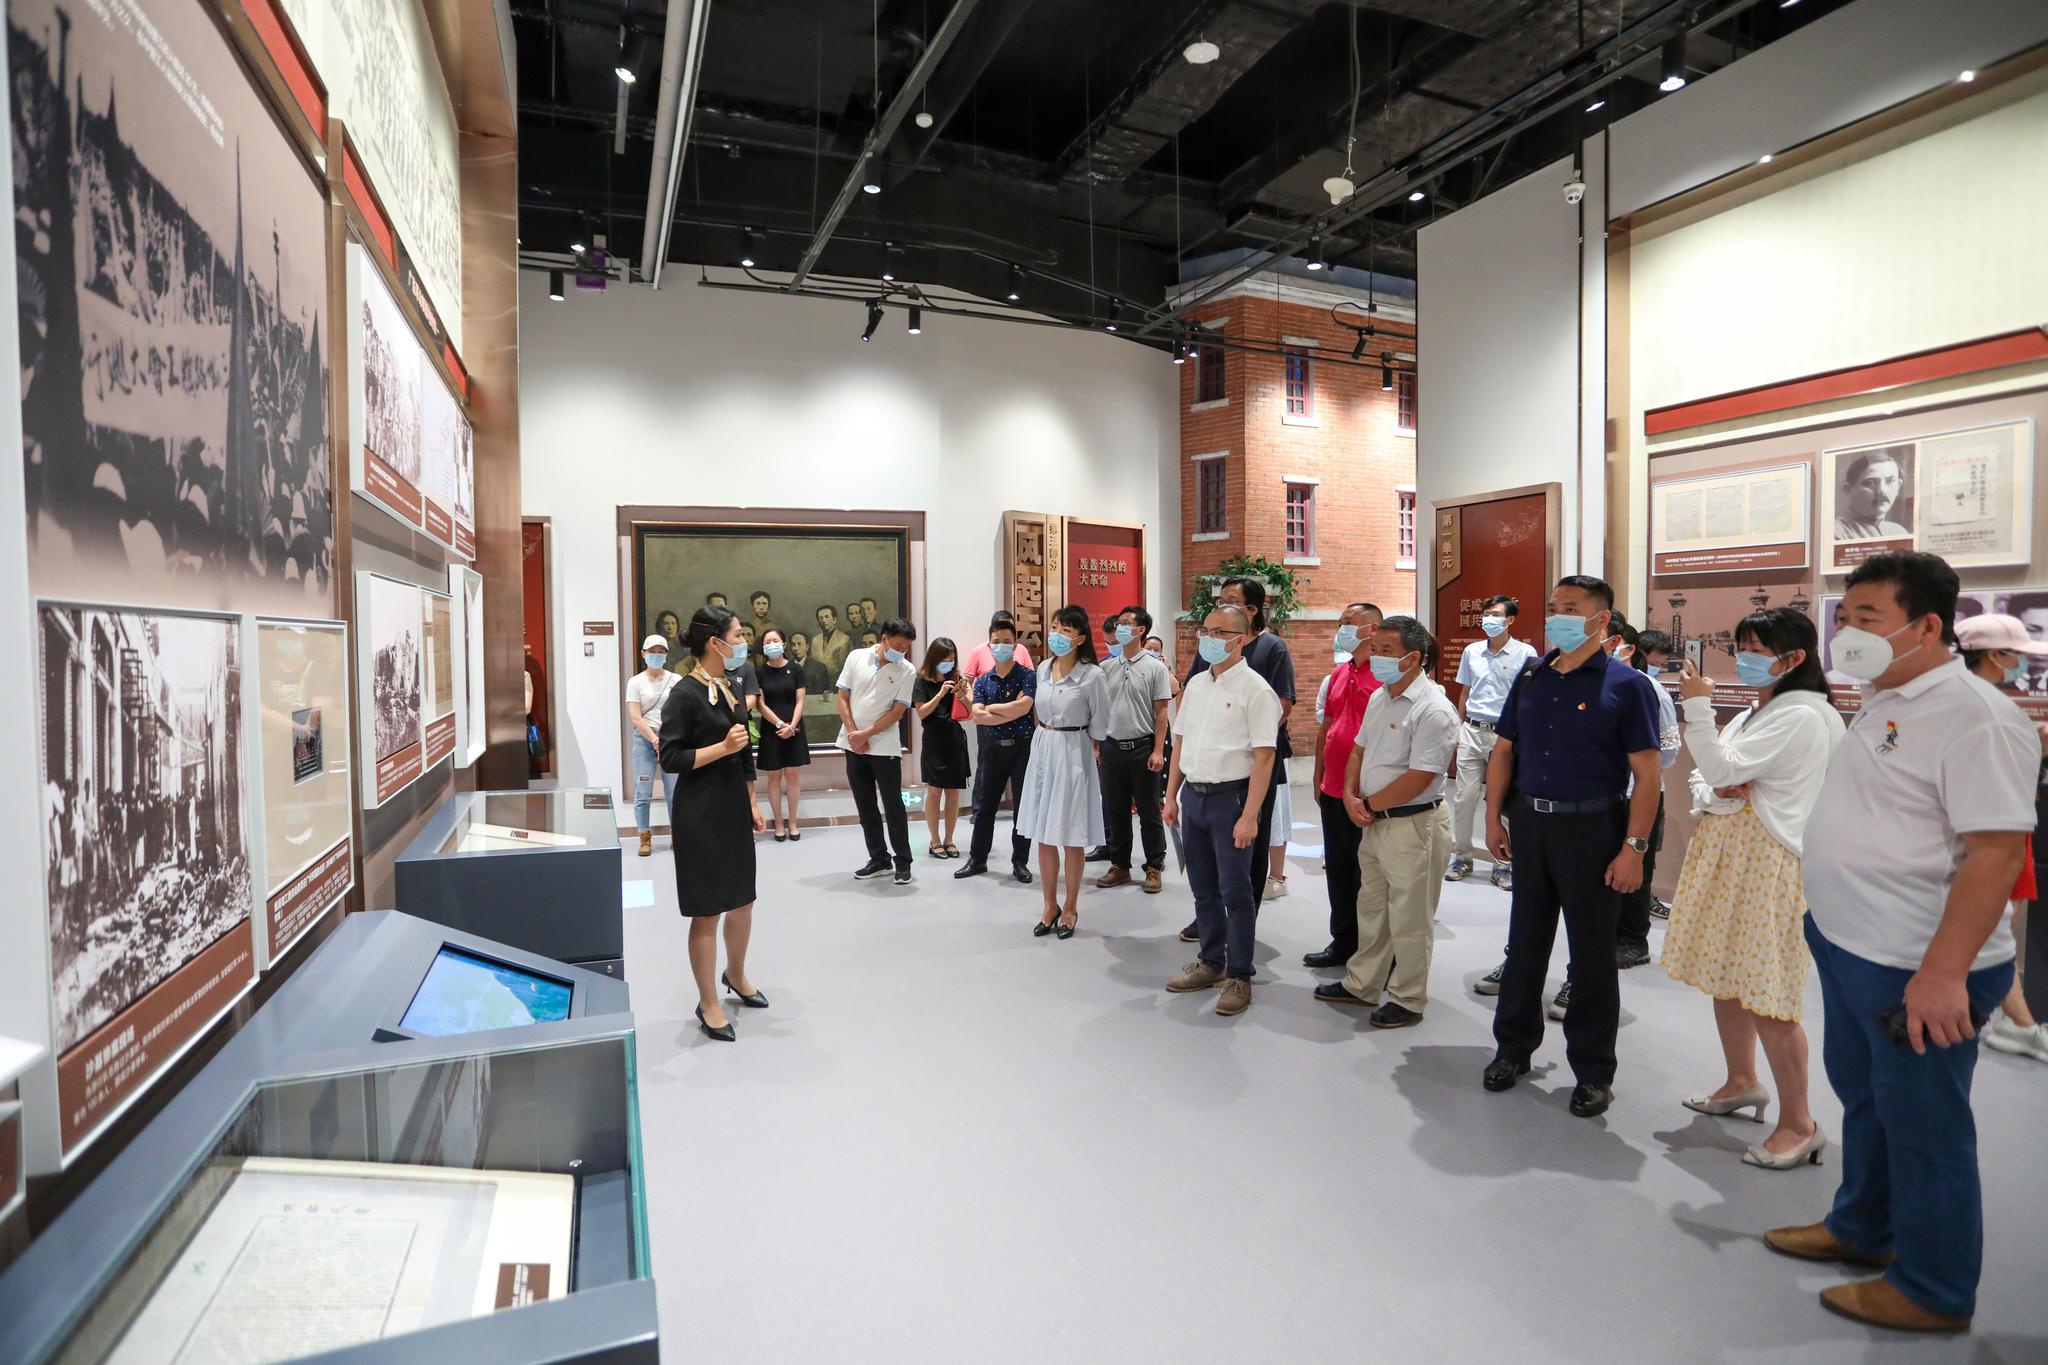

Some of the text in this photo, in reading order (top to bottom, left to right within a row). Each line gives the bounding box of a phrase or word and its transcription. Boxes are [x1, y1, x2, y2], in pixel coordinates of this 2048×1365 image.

[1441, 514, 1453, 569] 第一单元
[1079, 557, 1127, 573] 轰轰烈烈的
[1079, 573, 1108, 587] 大革命
[1017, 531, 1043, 664] 风起云
